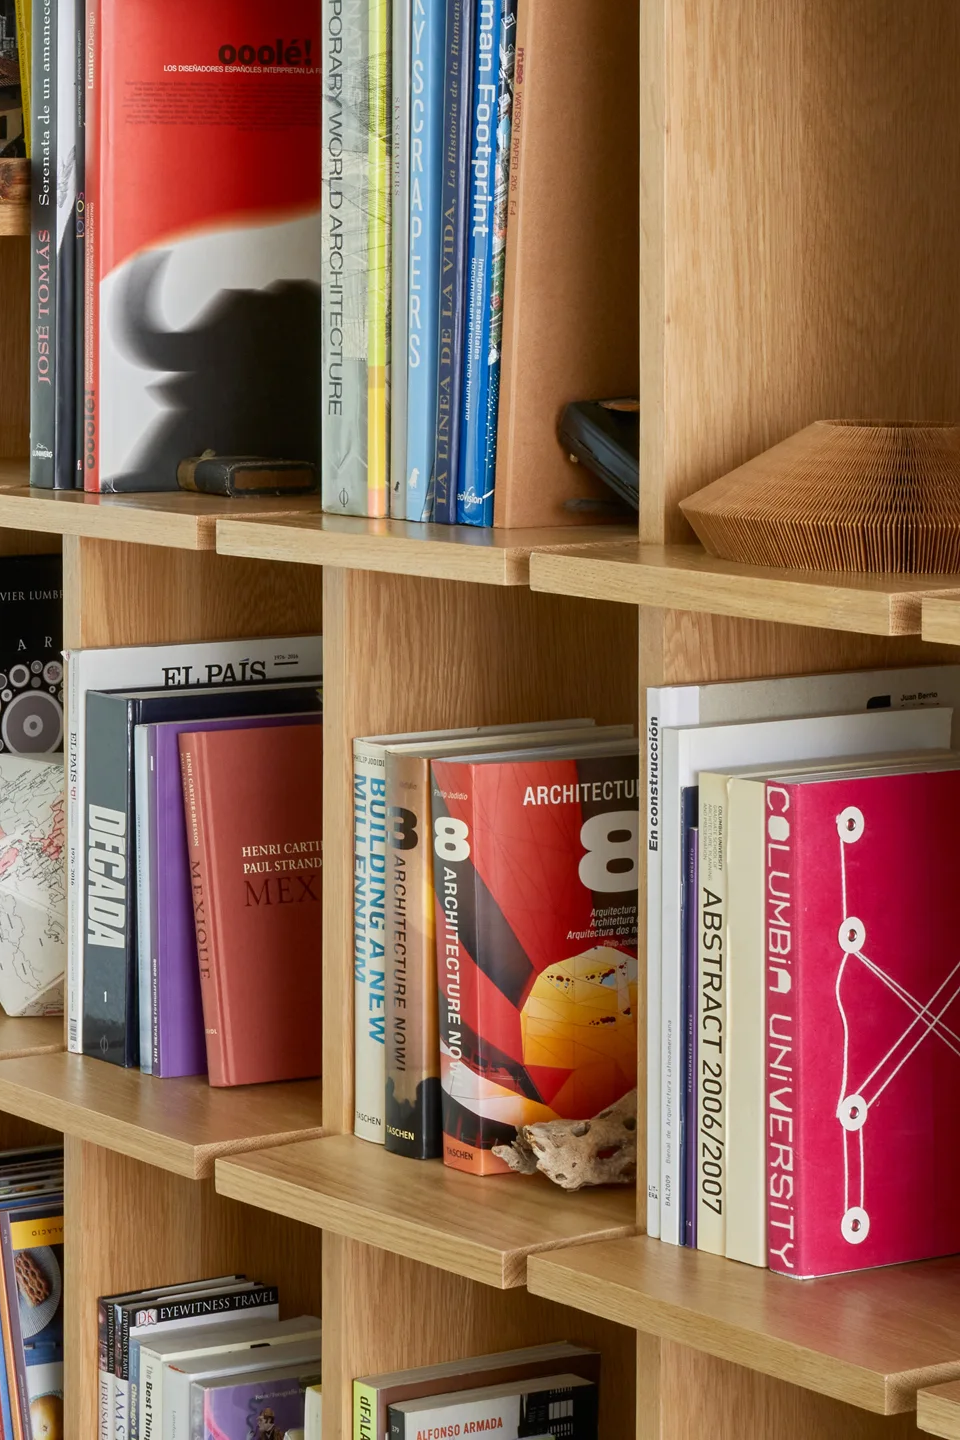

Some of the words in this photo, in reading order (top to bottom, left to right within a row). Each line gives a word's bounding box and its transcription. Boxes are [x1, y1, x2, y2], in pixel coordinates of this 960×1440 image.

[163, 64, 177, 72] LOS
[178, 64, 224, 73] DISEÑADORES
[225, 65, 261, 74] ESPAÑOLES
[218, 38, 313, 66] ooolé!
[516, 48, 524, 85] muse
[513, 91, 522, 133] WATSON
[38, 128, 50, 206] Serenata
[328, 106, 343, 210] WORLD
[471, 84, 497, 237] Footprint
[512, 137, 520, 170] PAPER
[38, 229, 50, 316] TOMÁS
[328, 221, 344, 416] ARCHITECTURE
[37, 325, 51, 385] JOSÉ
[441, 329, 452, 362] DE
[85, 389, 96, 470] ooolé!
[436, 374, 451, 449] LÍNEA
[435, 466, 448, 506] LA
[162, 666, 200, 687] EL
[205, 657, 266, 685] PAÍS
[900, 693, 917, 702] Juan
[917, 691, 938, 699] Berrio
[648, 716, 658, 826] construcción
[242, 845, 281, 858] HENRI
[369, 777, 385, 929] BUILDING
[434, 816, 471, 862] 8
[649, 828, 658, 852] En
[87, 803, 126, 949] DECADA
[243, 861, 272, 874] PAUL
[275, 857, 322, 872] STRAND
[354, 773, 367, 985] MILLENNIUM
[245, 874, 320, 907] MEX
[590, 905, 636, 919] Arquitectura
[766, 784, 792, 995] COLUMBIA
[190, 860, 210, 980] MEXIQUE
[393, 854, 407, 1009] ARCHITECTURE
[567, 928, 614, 941] Arquitectura
[442, 866, 462, 1025] ARCHITECTURE
[703, 887, 723, 1053] ABSTRACT
[369, 970, 386, 1045] NEW
[356, 1111, 381, 1127] TASCHEN
[386, 1124, 415, 1141] TASCHEN
[701, 1059, 724, 1216] 2006/2007
[446, 1146, 473, 1161] TASCHEN
[769, 1015, 796, 1270] UNIVERSITY
[138, 1310, 155, 1324] DK
[160, 1297, 230, 1320] EYEWITNESS
[233, 1291, 275, 1307] TRAVEL
[416, 1424, 461, 1440] ALFONSO
[463, 1416, 503, 1434] ARMADA
